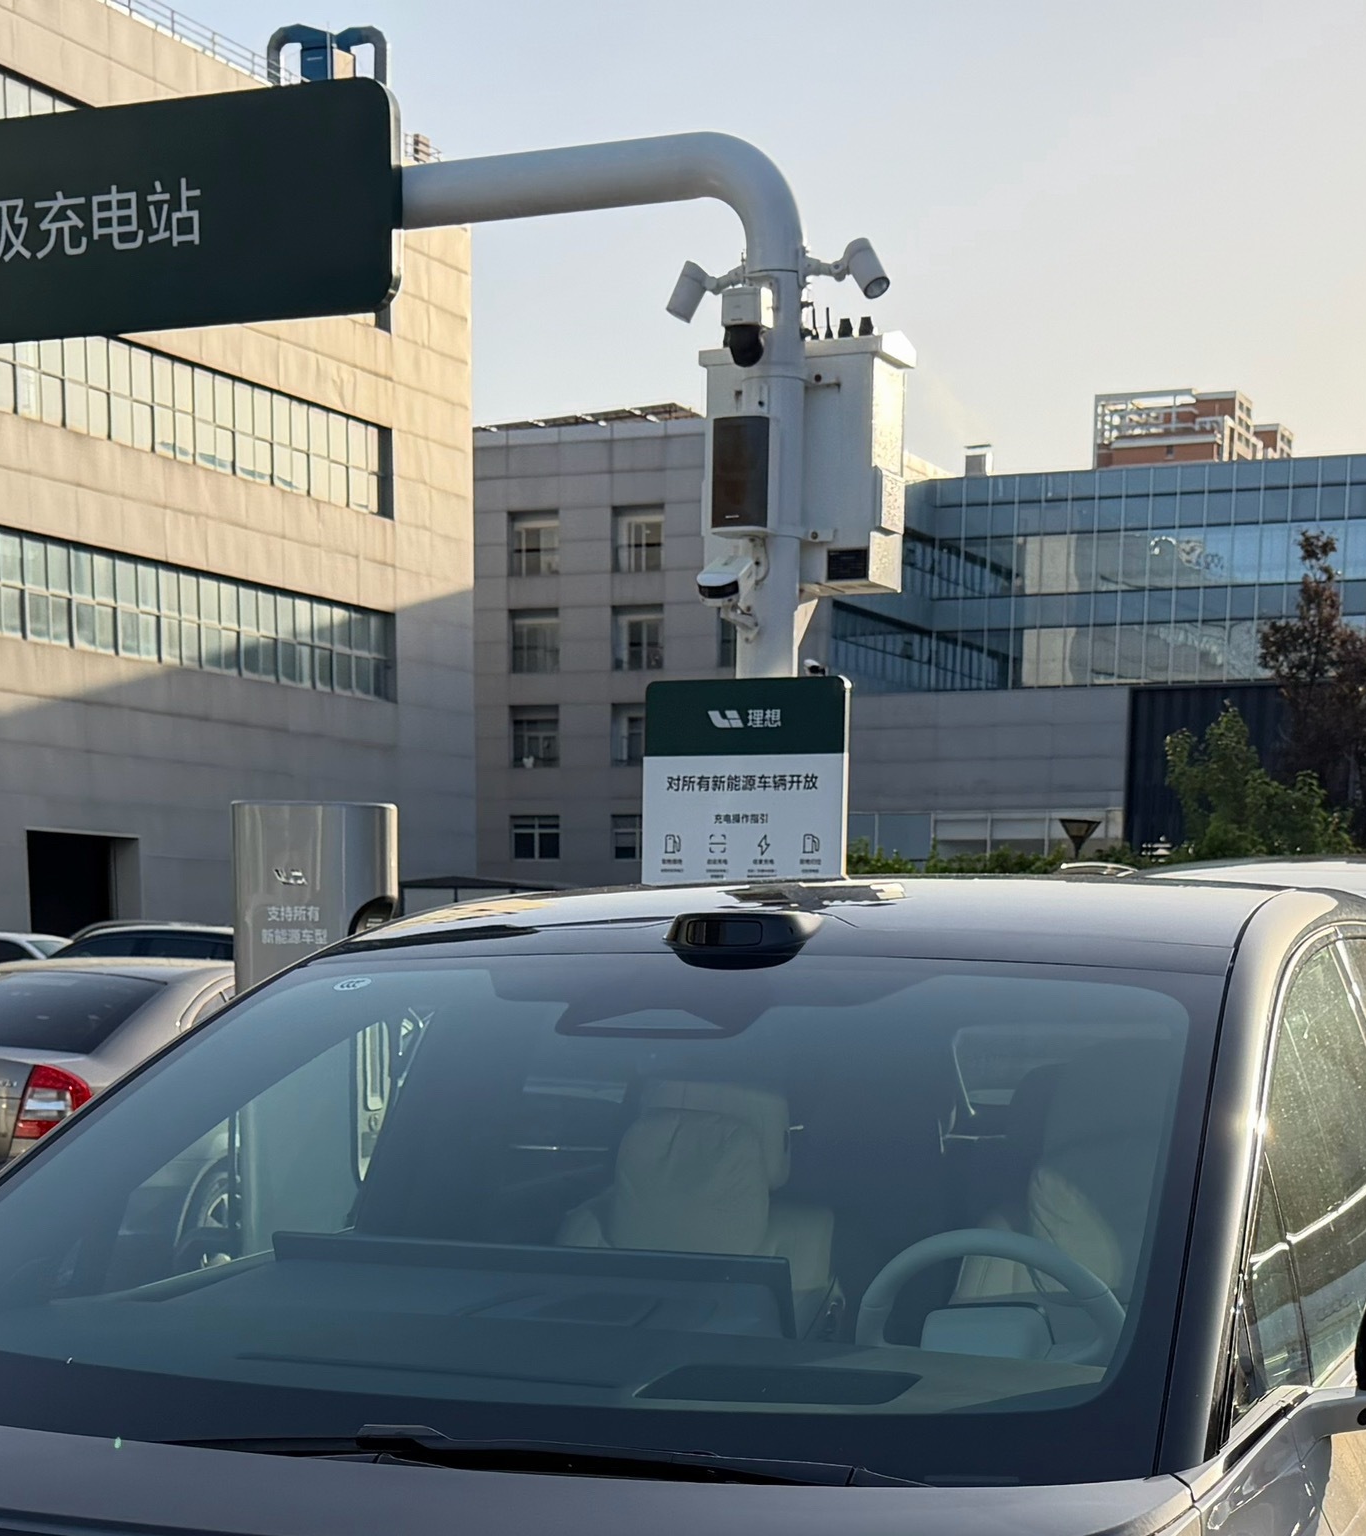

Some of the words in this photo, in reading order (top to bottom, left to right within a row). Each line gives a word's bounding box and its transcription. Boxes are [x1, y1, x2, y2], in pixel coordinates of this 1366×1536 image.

[747, 709, 781, 728] 理想
[667, 774, 818, 792] 对所有新能源车辆开放
[714, 813, 769, 825] 充电操作指引
[267, 906, 320, 922] 支持所有
[262, 929, 328, 945] 新能源车型
